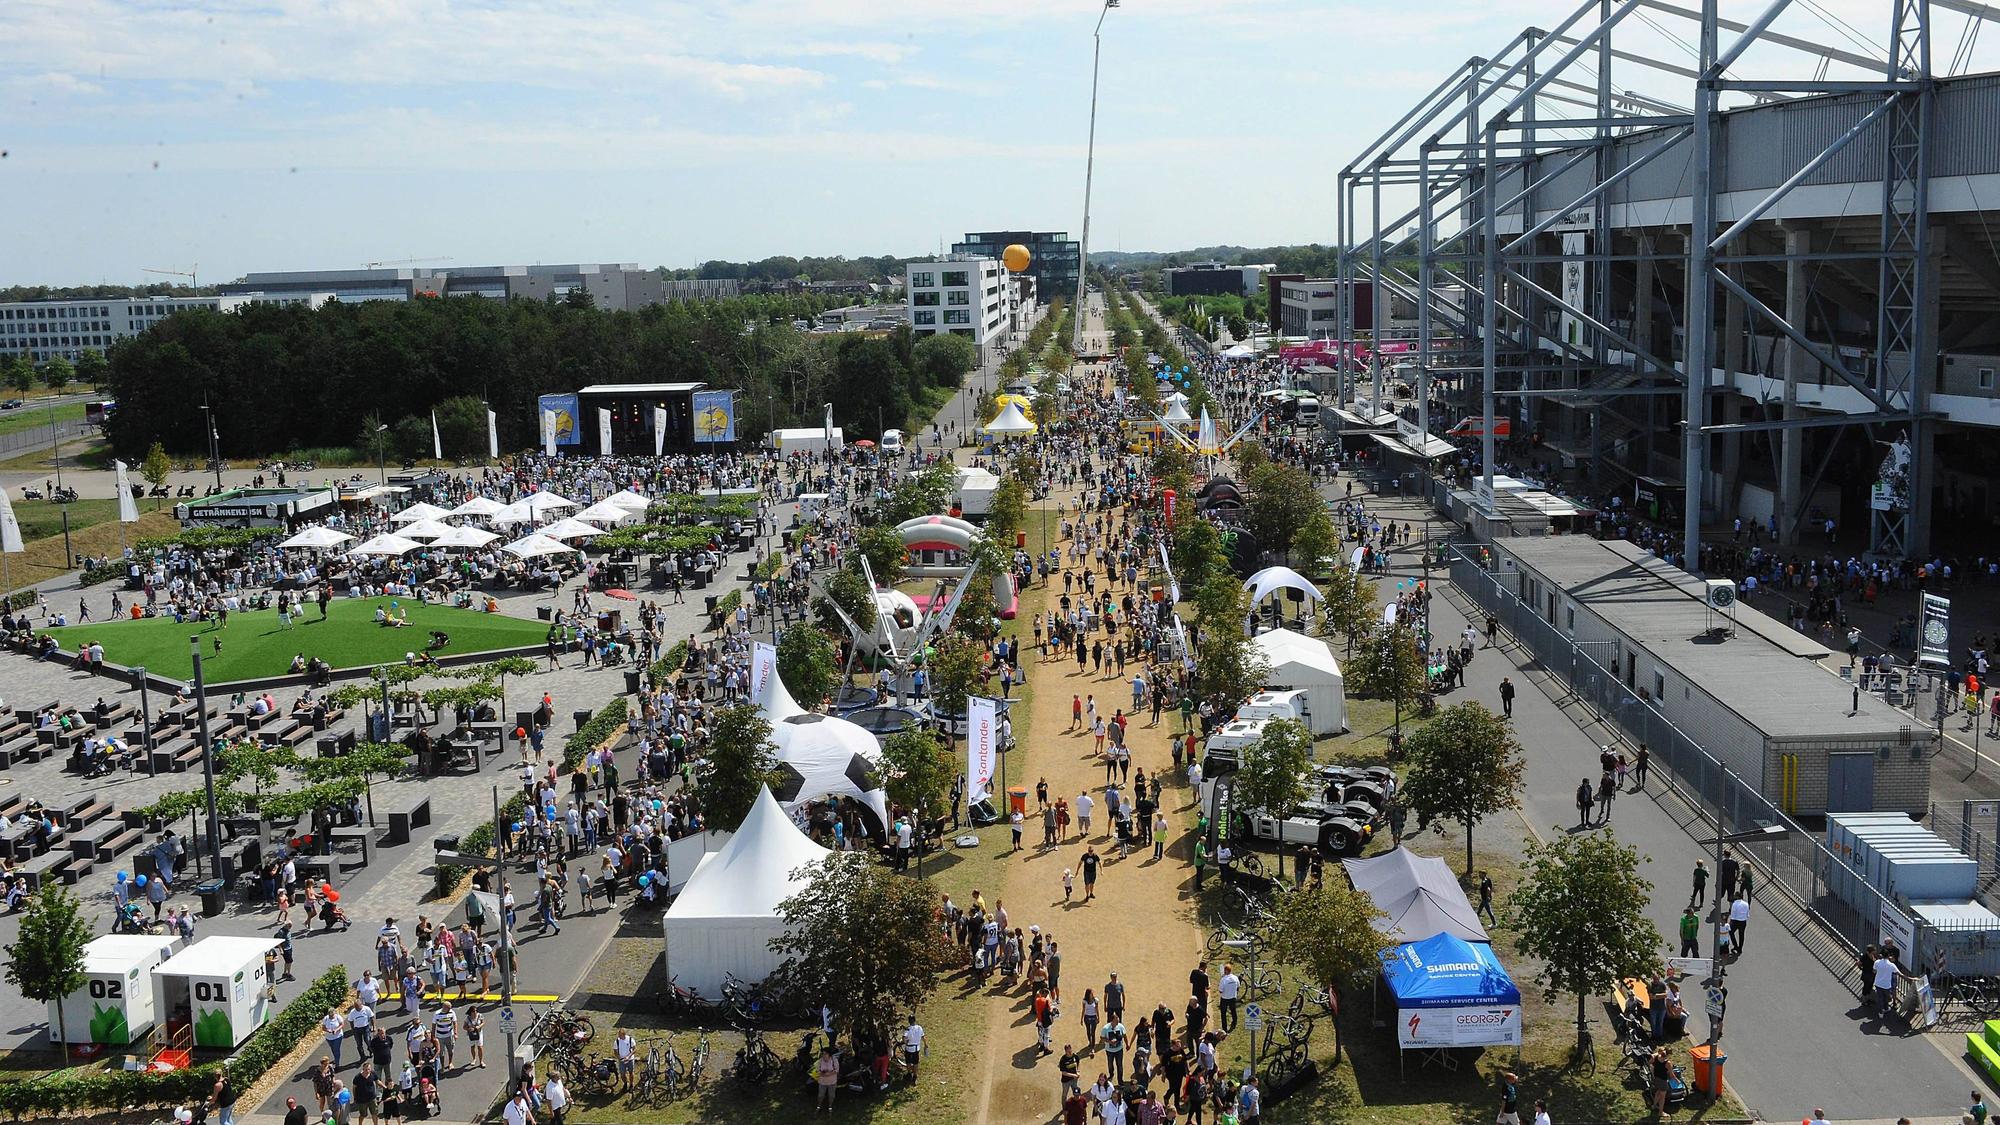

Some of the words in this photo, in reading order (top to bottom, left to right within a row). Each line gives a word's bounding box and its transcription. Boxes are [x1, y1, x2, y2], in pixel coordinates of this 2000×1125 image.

[978, 719, 989, 776] Santander
[254, 965, 265, 980] 01
[1426, 962, 1479, 974] SHIMANO
[89, 979, 123, 999] 02
[194, 981, 228, 1002] 01
[1456, 1014, 1500, 1025] GEORGS
